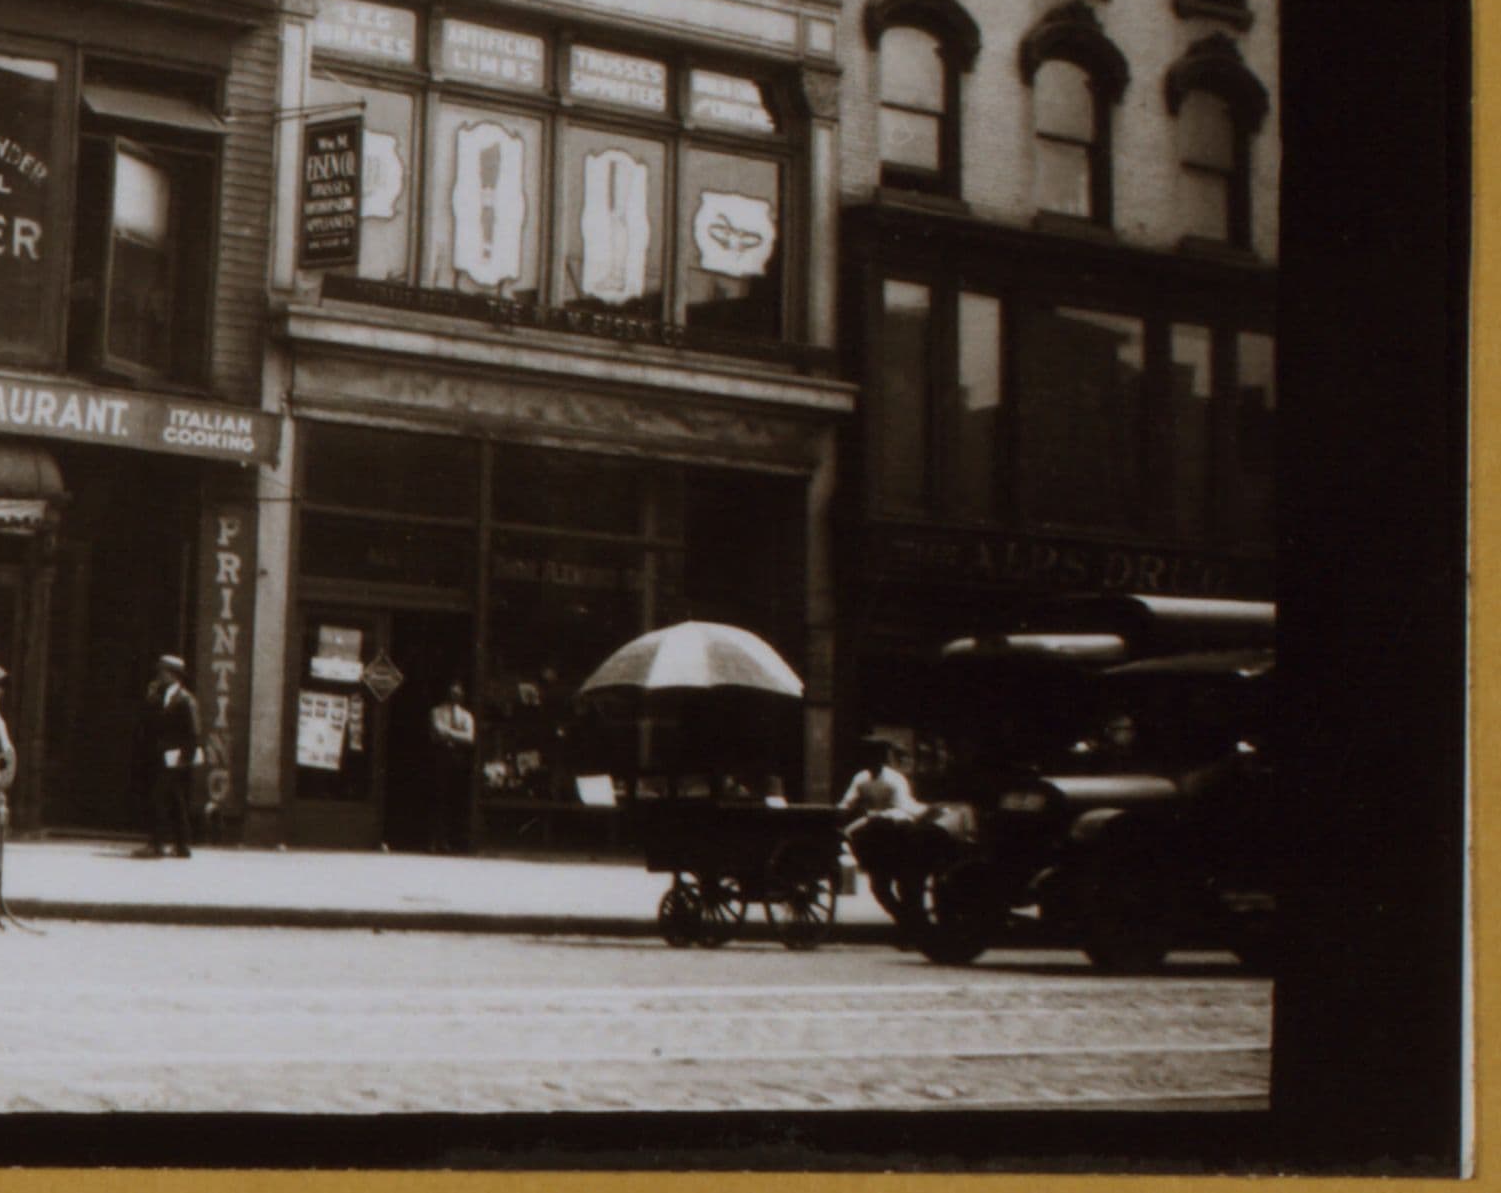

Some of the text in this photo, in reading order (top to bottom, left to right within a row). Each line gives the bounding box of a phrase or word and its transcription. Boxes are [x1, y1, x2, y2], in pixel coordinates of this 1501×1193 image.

[169, 408, 254, 434] ITALIAN
[163, 427, 256, 453] COOKING
[206, 516, 242, 803] PRINTING
